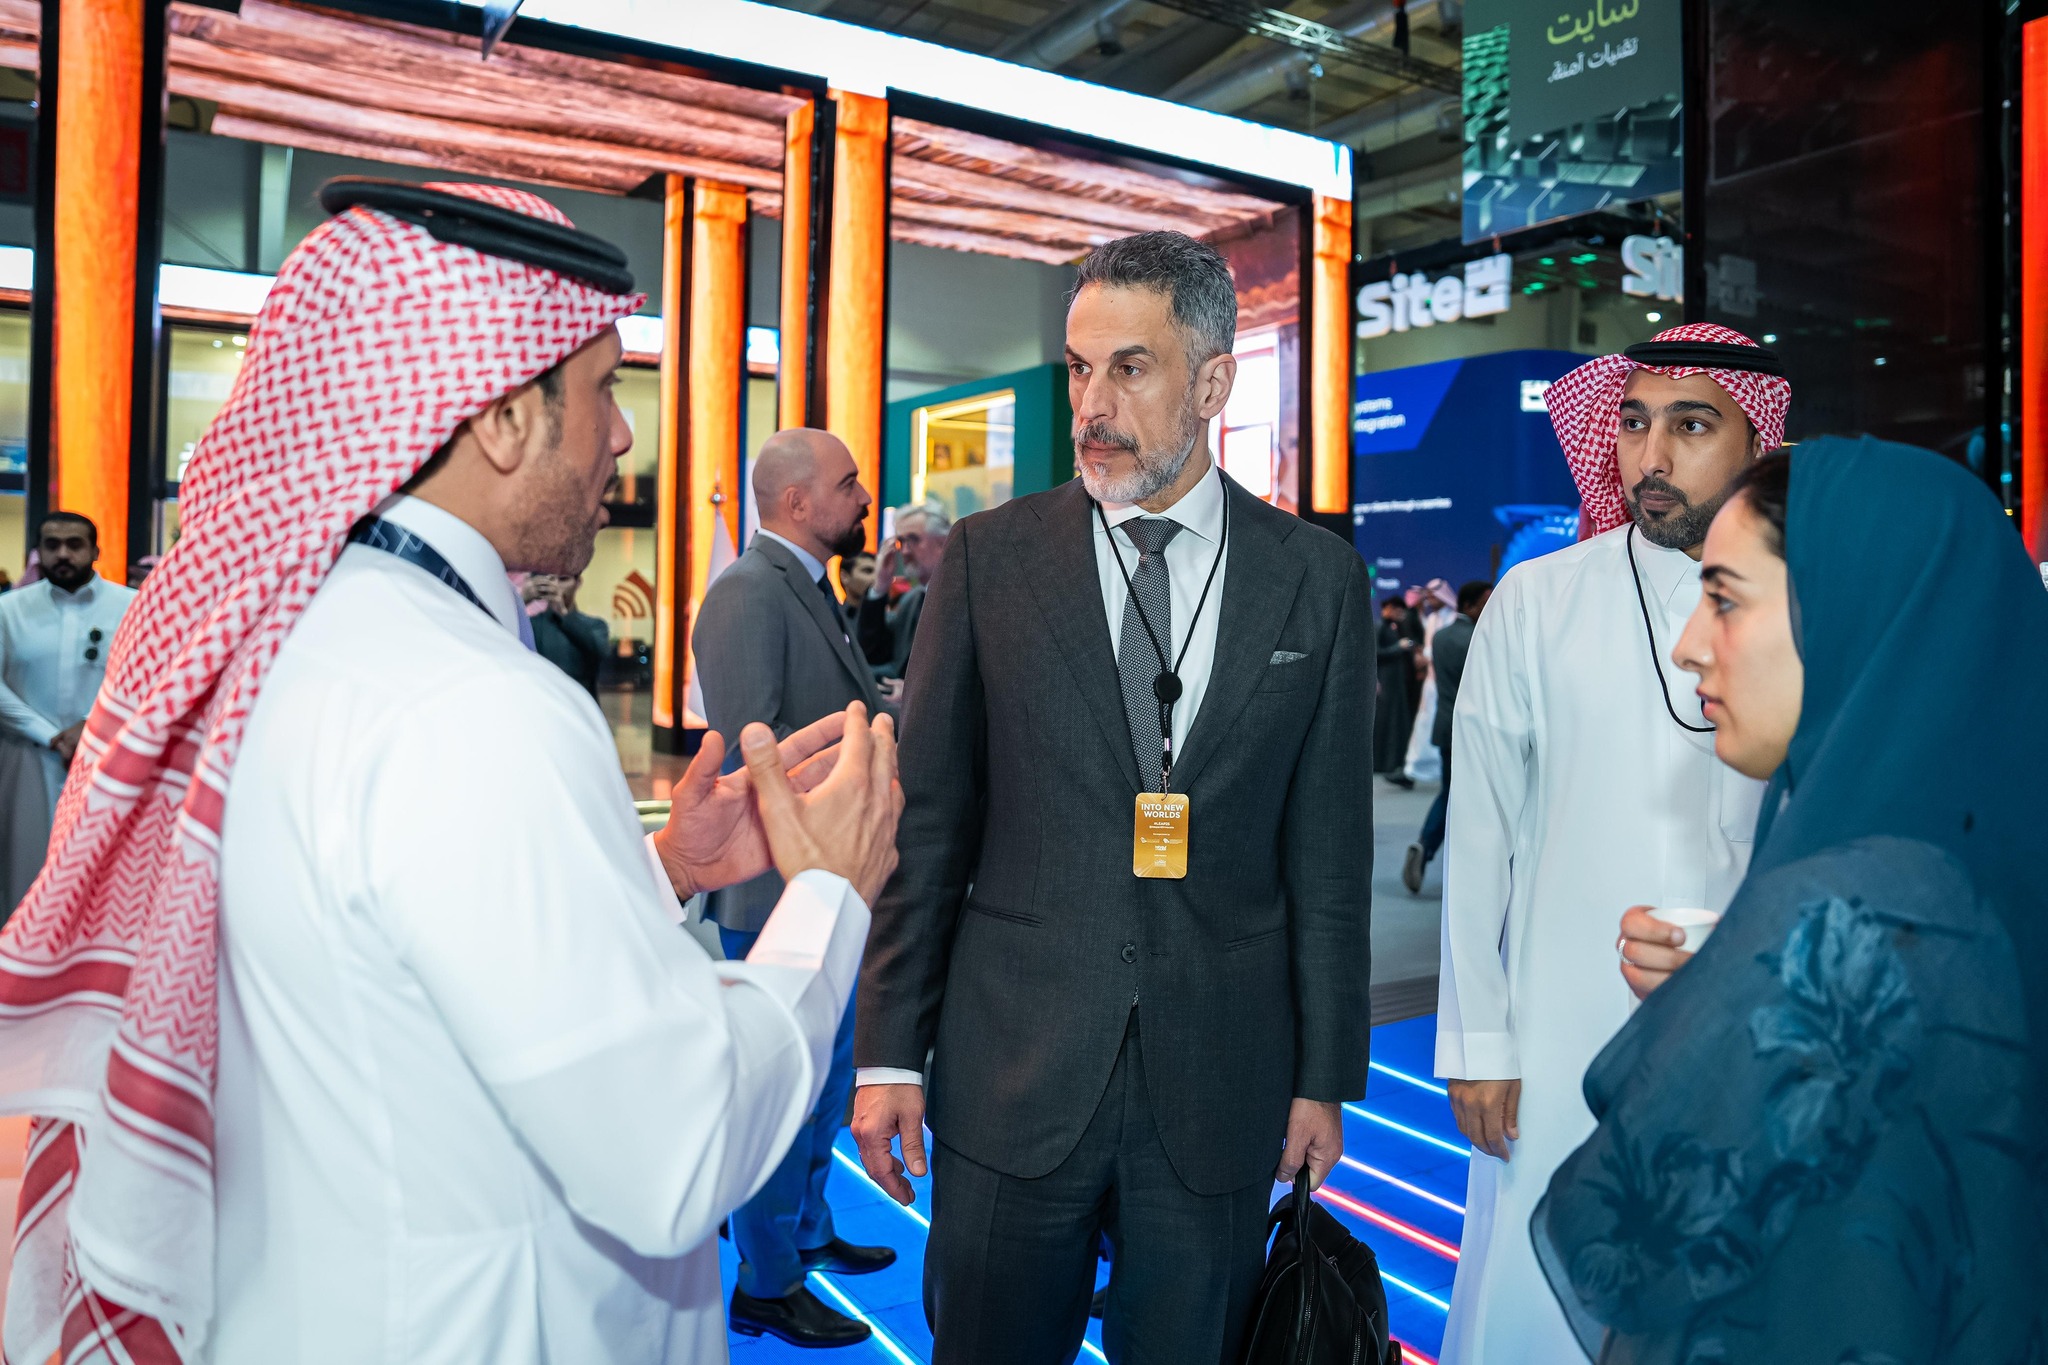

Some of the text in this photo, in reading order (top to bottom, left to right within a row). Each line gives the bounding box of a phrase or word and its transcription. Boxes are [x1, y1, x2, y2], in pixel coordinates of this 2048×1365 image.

[1547, 0, 1640, 45] سايت
[1621, 234, 1684, 304] Si
[1141, 803, 1184, 812] INTO NEW
[1144, 811, 1181, 819] WORLDS
